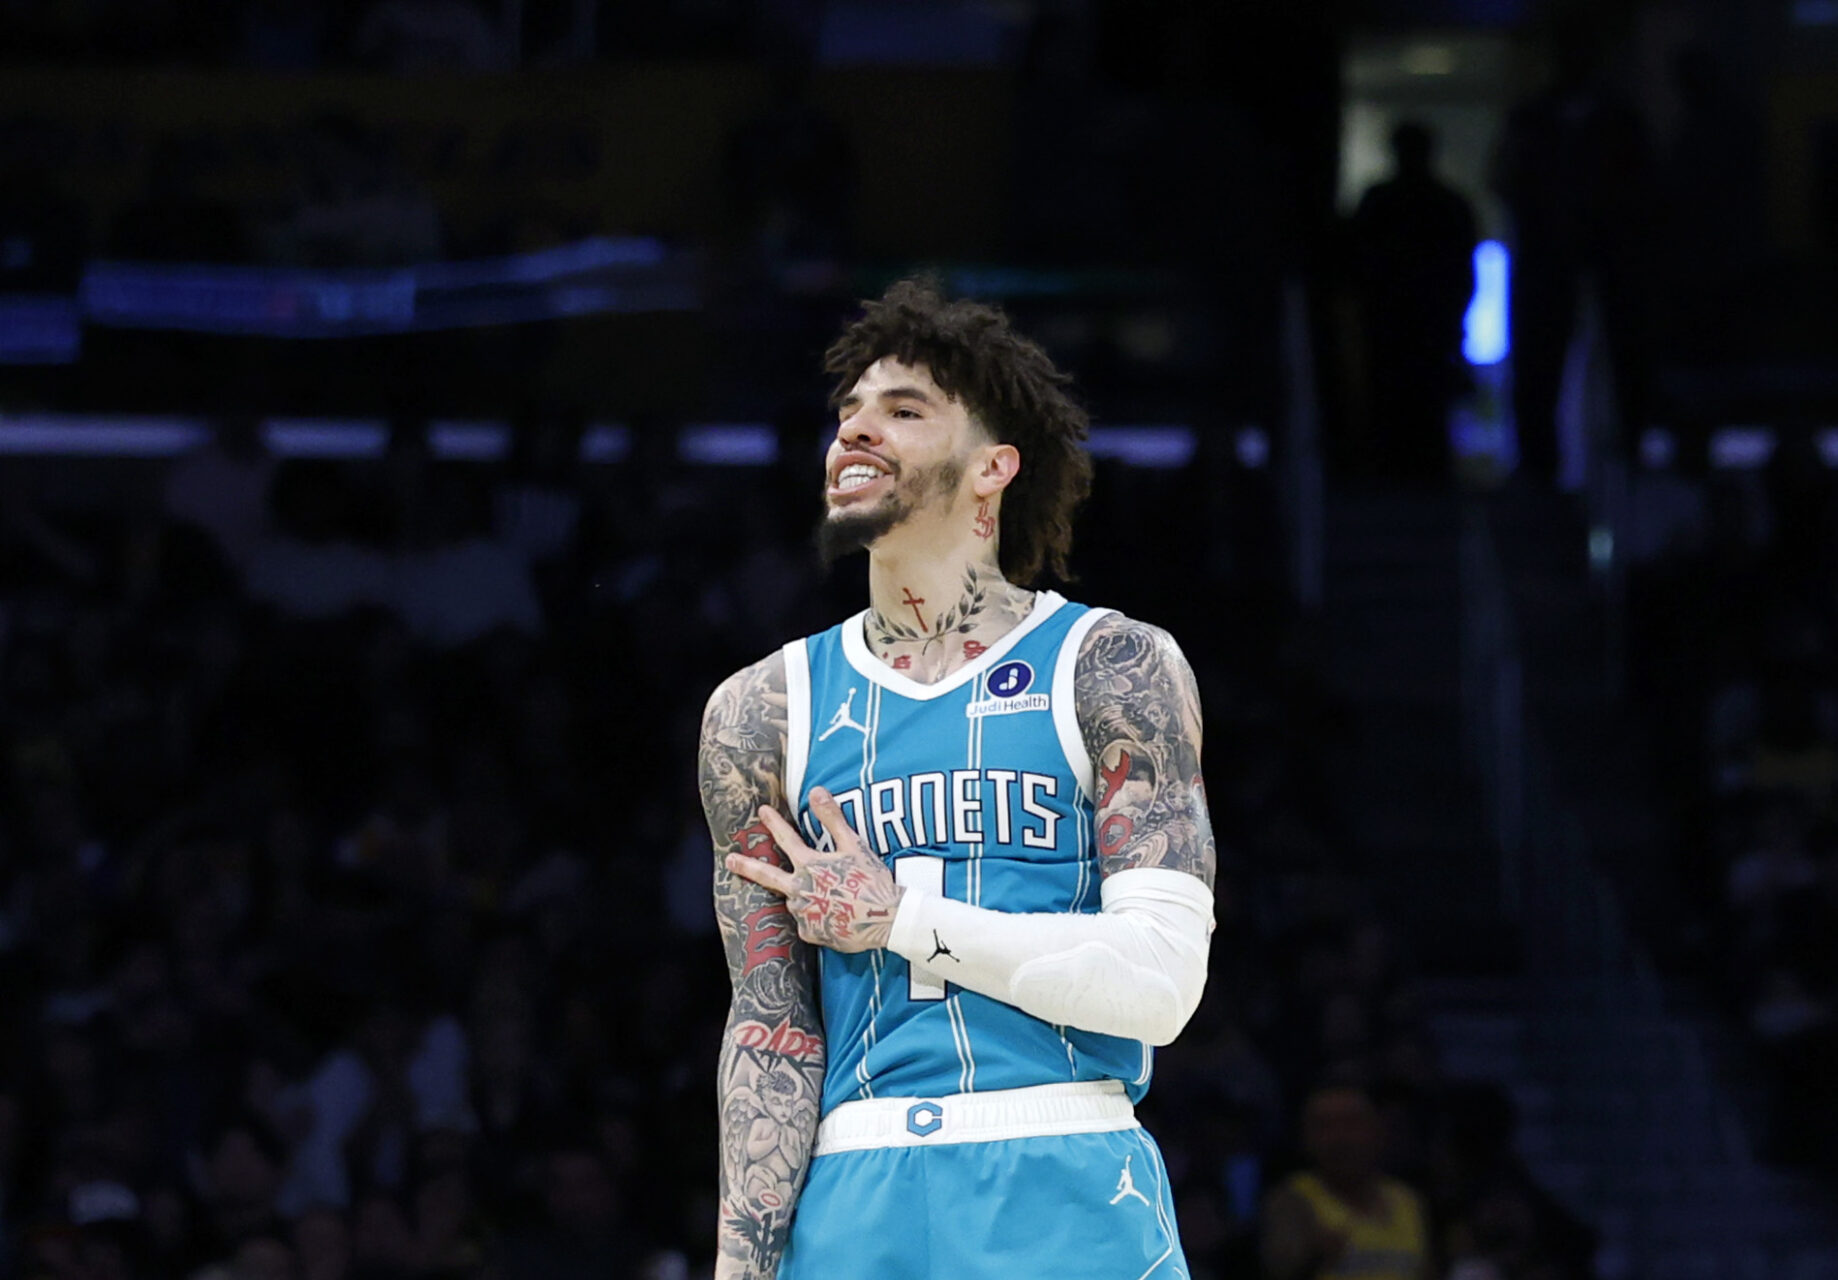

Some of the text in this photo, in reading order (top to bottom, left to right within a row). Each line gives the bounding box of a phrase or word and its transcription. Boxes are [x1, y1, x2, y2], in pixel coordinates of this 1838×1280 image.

[969, 696, 1047, 716] Judi Health
[801, 867, 839, 927] HERE
[842, 869, 871, 900] NOT
[906, 1101, 943, 1137] C
